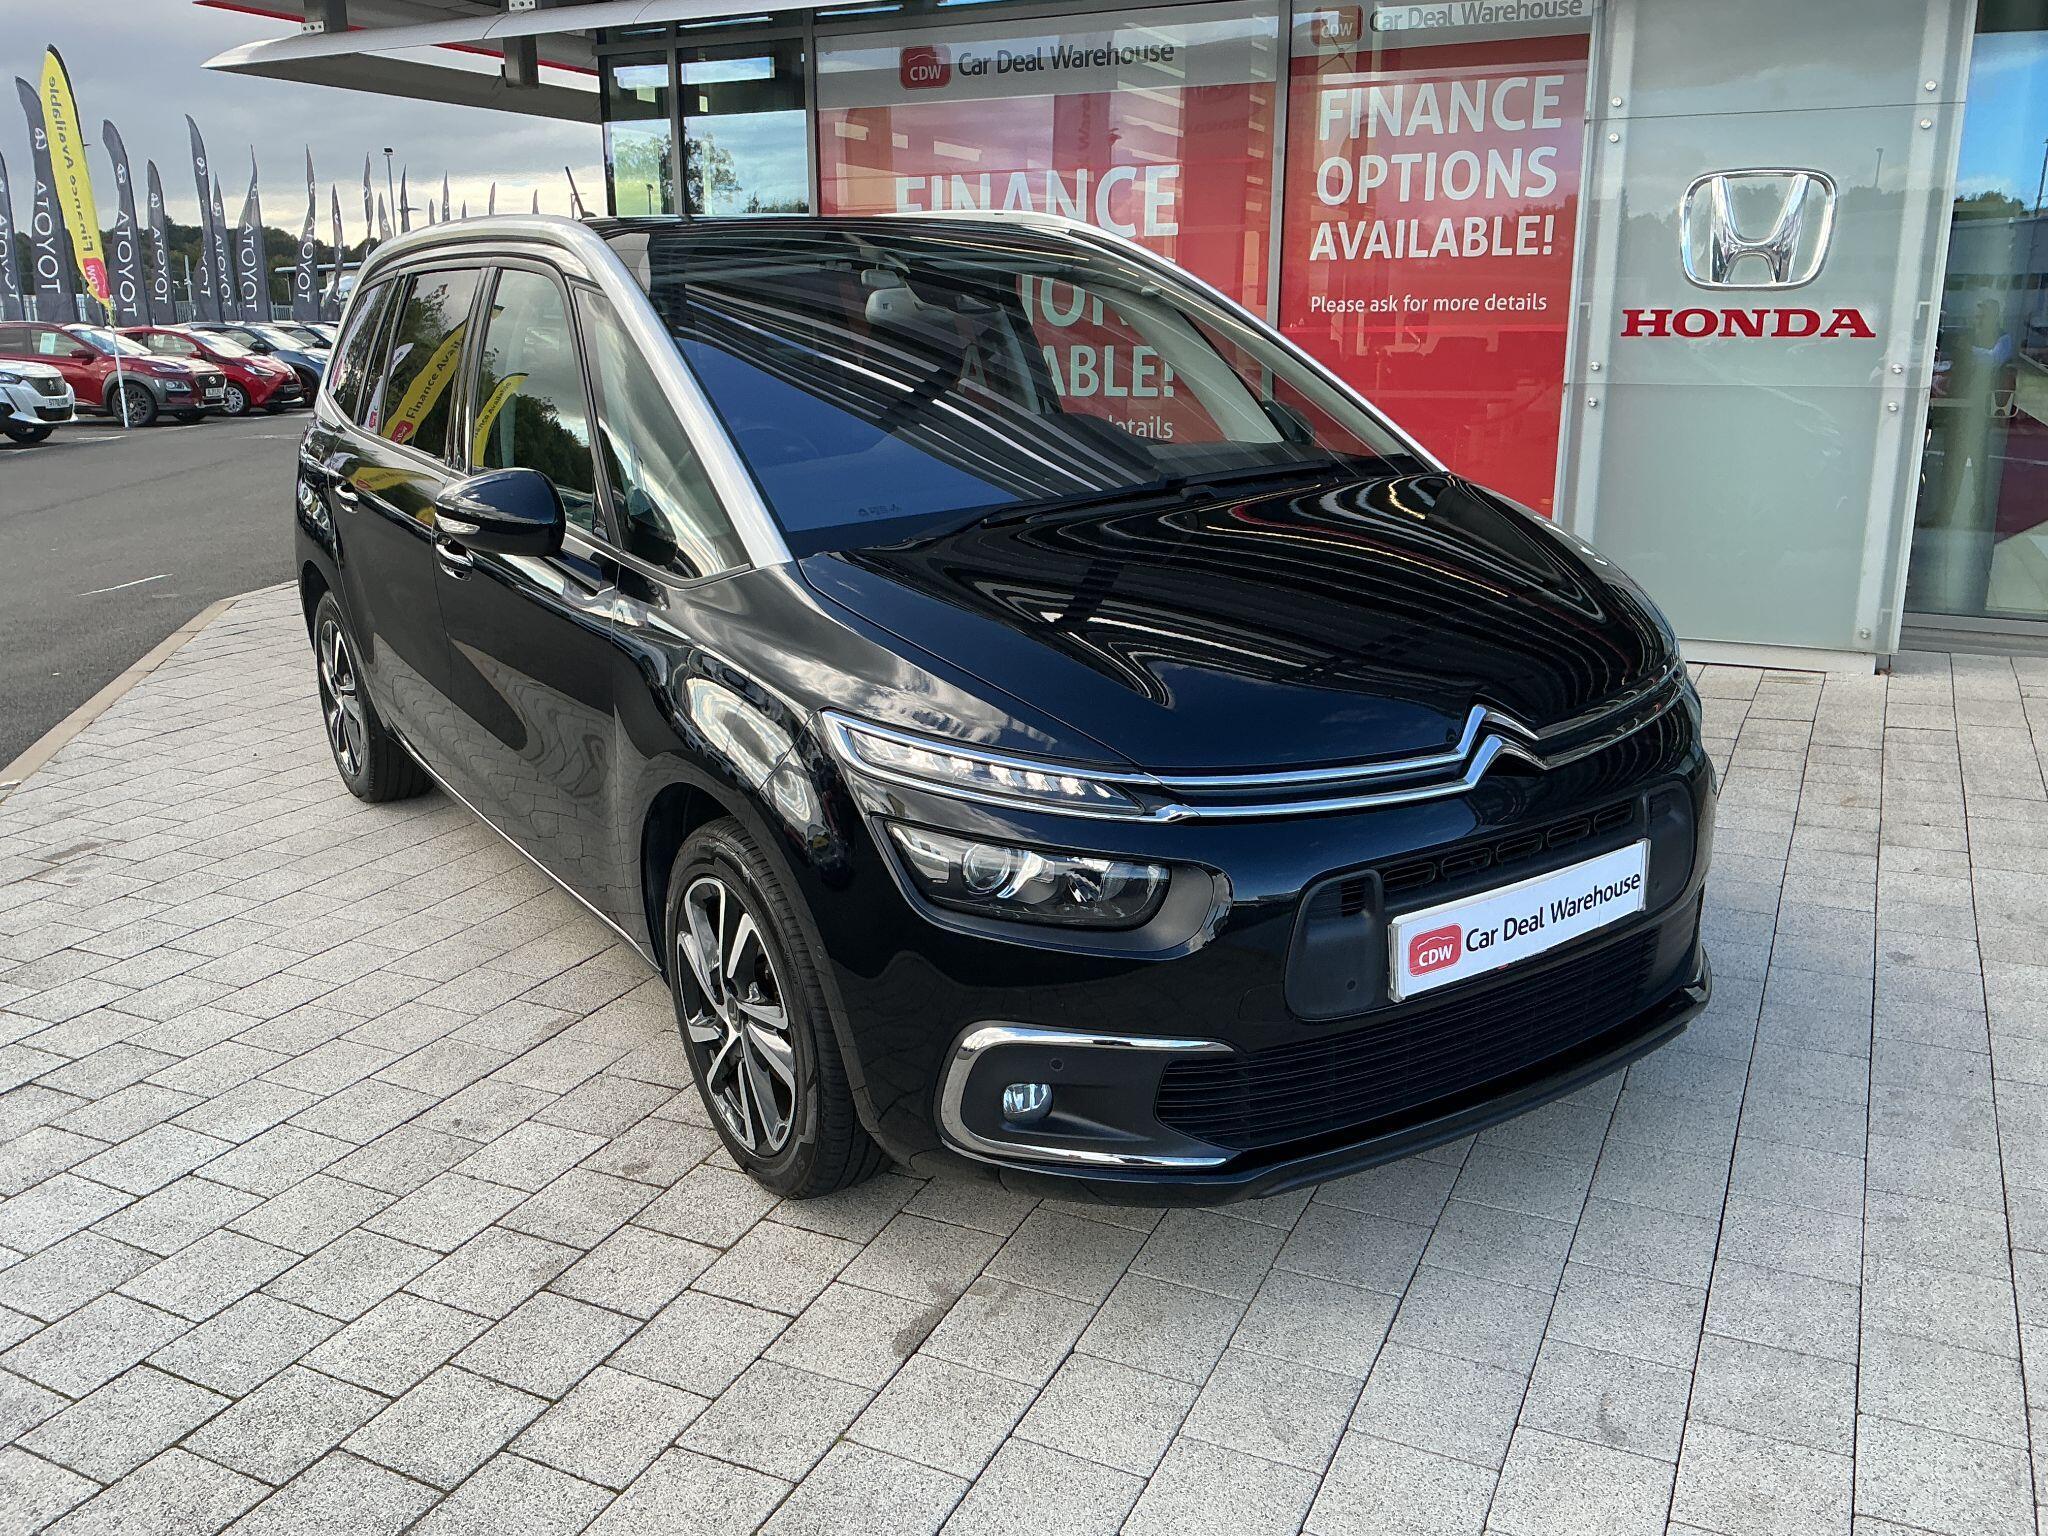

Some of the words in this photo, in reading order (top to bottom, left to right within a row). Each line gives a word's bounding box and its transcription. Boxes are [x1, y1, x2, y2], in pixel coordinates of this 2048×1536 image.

[1370, 11, 1403, 33] Car
[1408, 7, 1454, 29] Deal
[1461, 0, 1583, 24] Warehouse
[909, 64, 942, 82] CDW
[958, 52, 988, 77] Car
[997, 46, 1044, 75] Deal
[1050, 42, 1175, 70] Warehouse
[1318, 75, 1565, 141] FINANCE
[1316, 146, 1557, 206] OPTIONS
[1309, 215, 1555, 261] AVAILABLE!
[1311, 296, 1366, 313] Please
[1371, 295, 1398, 312] ask
[1403, 294, 1429, 312] for
[1433, 298, 1479, 312] more
[1485, 293, 1548, 312] details
[1620, 308, 1876, 338] HONDA
[405, 372, 439, 421] Finance
[1466, 928, 1498, 952] Car
[1503, 907, 1545, 941] Deal
[1550, 873, 1641, 924] Warehouse
[1418, 944, 1453, 967] CDW
